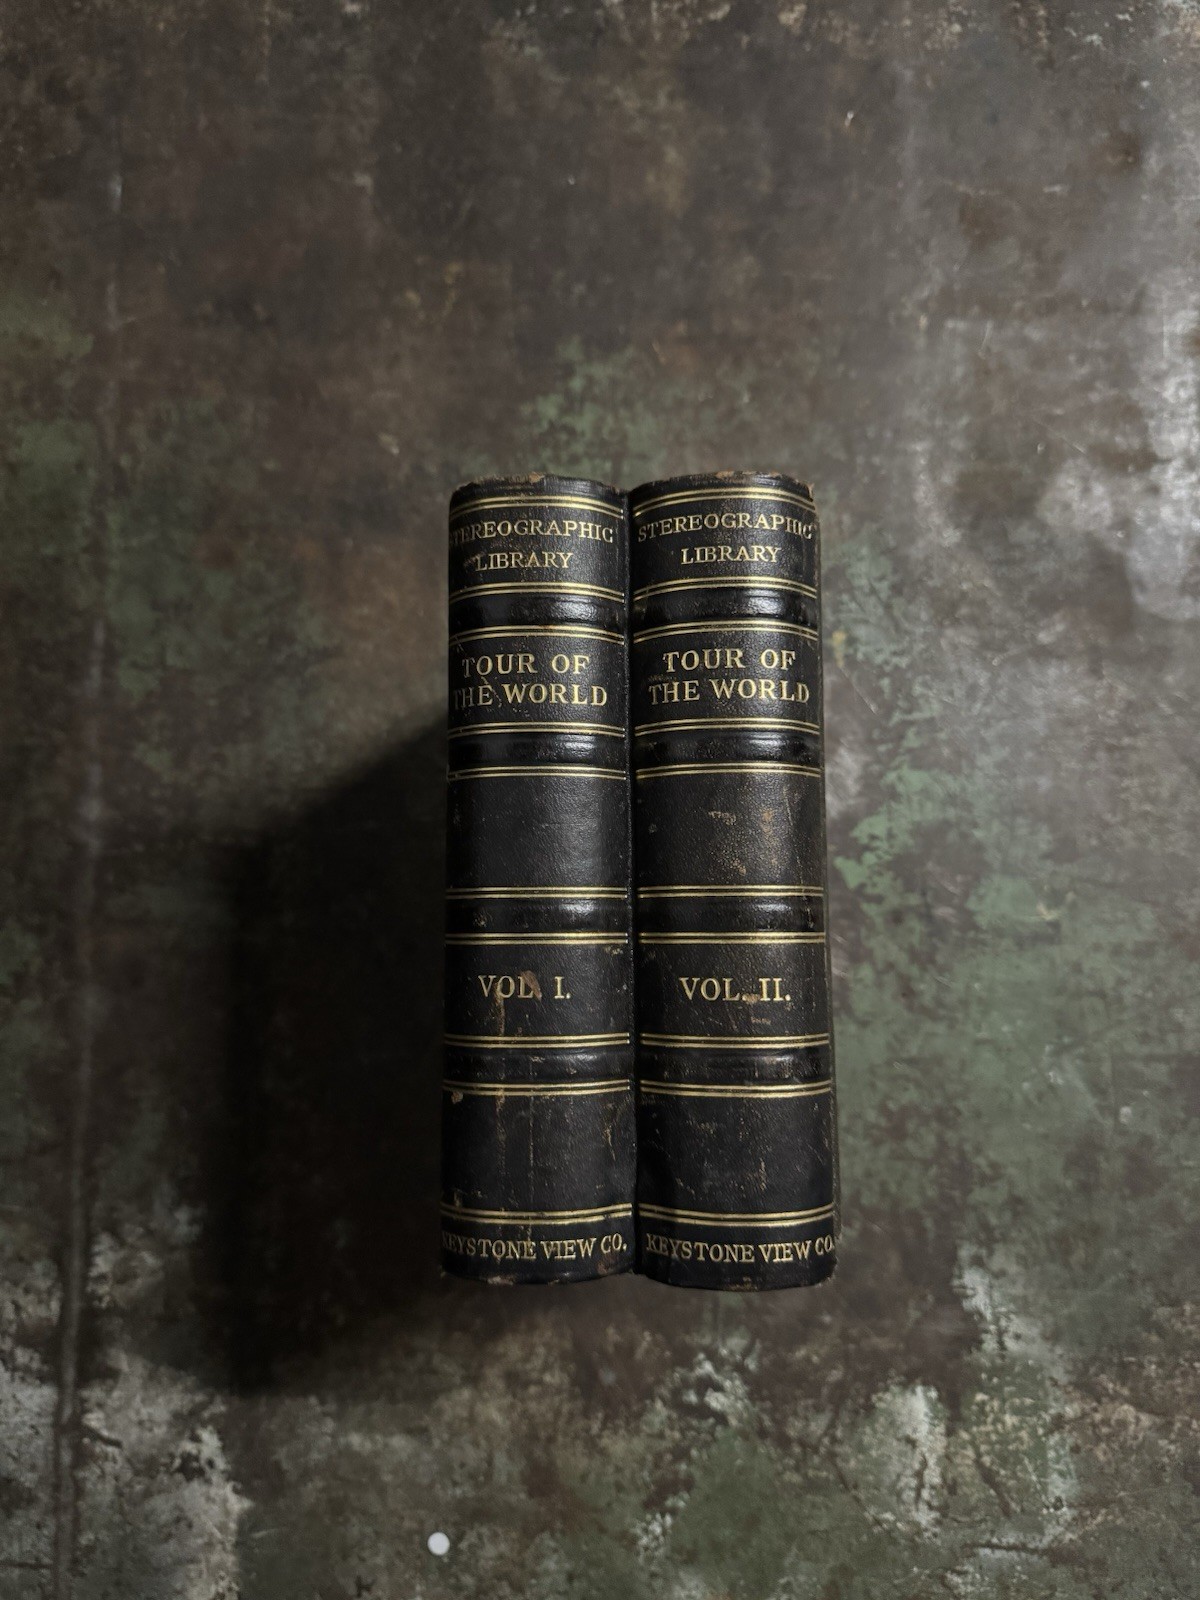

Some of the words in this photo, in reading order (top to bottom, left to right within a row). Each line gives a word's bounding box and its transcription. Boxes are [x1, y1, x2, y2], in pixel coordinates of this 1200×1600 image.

[638, 512, 813, 542] STEREOGRAPHIC
[475, 550, 574, 572] LIBRARY
[681, 545, 782, 566] LIBRARY
[461, 652, 538, 679] TOUR
[551, 653, 591, 675] OF
[662, 647, 746, 673] TOUR
[760, 648, 797, 672] OF
[454, 684, 493, 710] THE
[501, 682, 608, 707] WORLD
[648, 679, 700, 706] THE
[713, 678, 810, 704] WORLD
[554, 975, 572, 999] I.
[679, 977, 747, 1001] VOL.
[758, 977, 792, 1001] II.
[442, 1230, 537, 1260] KEYSTONE
[540, 1237, 598, 1260] VIEW
[600, 1232, 628, 1254] CO.
[645, 1233, 756, 1263] KEYSTONE
[758, 1239, 812, 1263] VIEW
